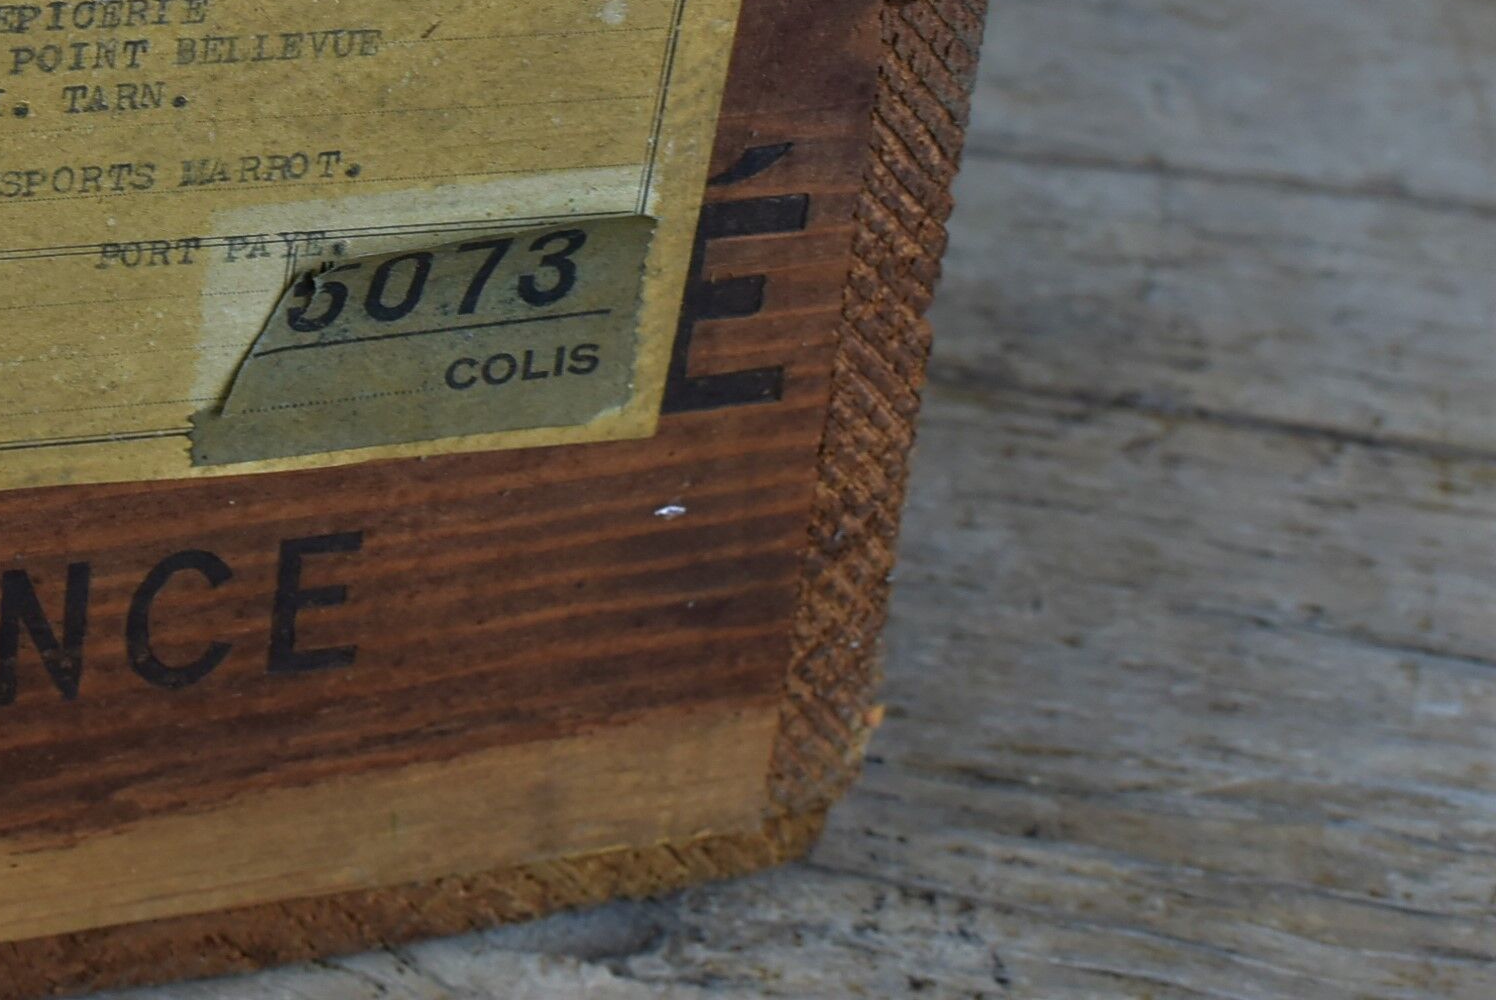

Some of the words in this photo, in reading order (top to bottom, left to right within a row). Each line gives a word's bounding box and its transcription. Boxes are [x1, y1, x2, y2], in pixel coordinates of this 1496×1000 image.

[8, 40, 150, 76] POINT
[176, 30, 383, 67] BELLEVUE
[62, 81, 189, 114] TARN.
[95, 236, 201, 270] PORT
[287, 228, 587, 333] 5073
[444, 343, 600, 390] COLIS
